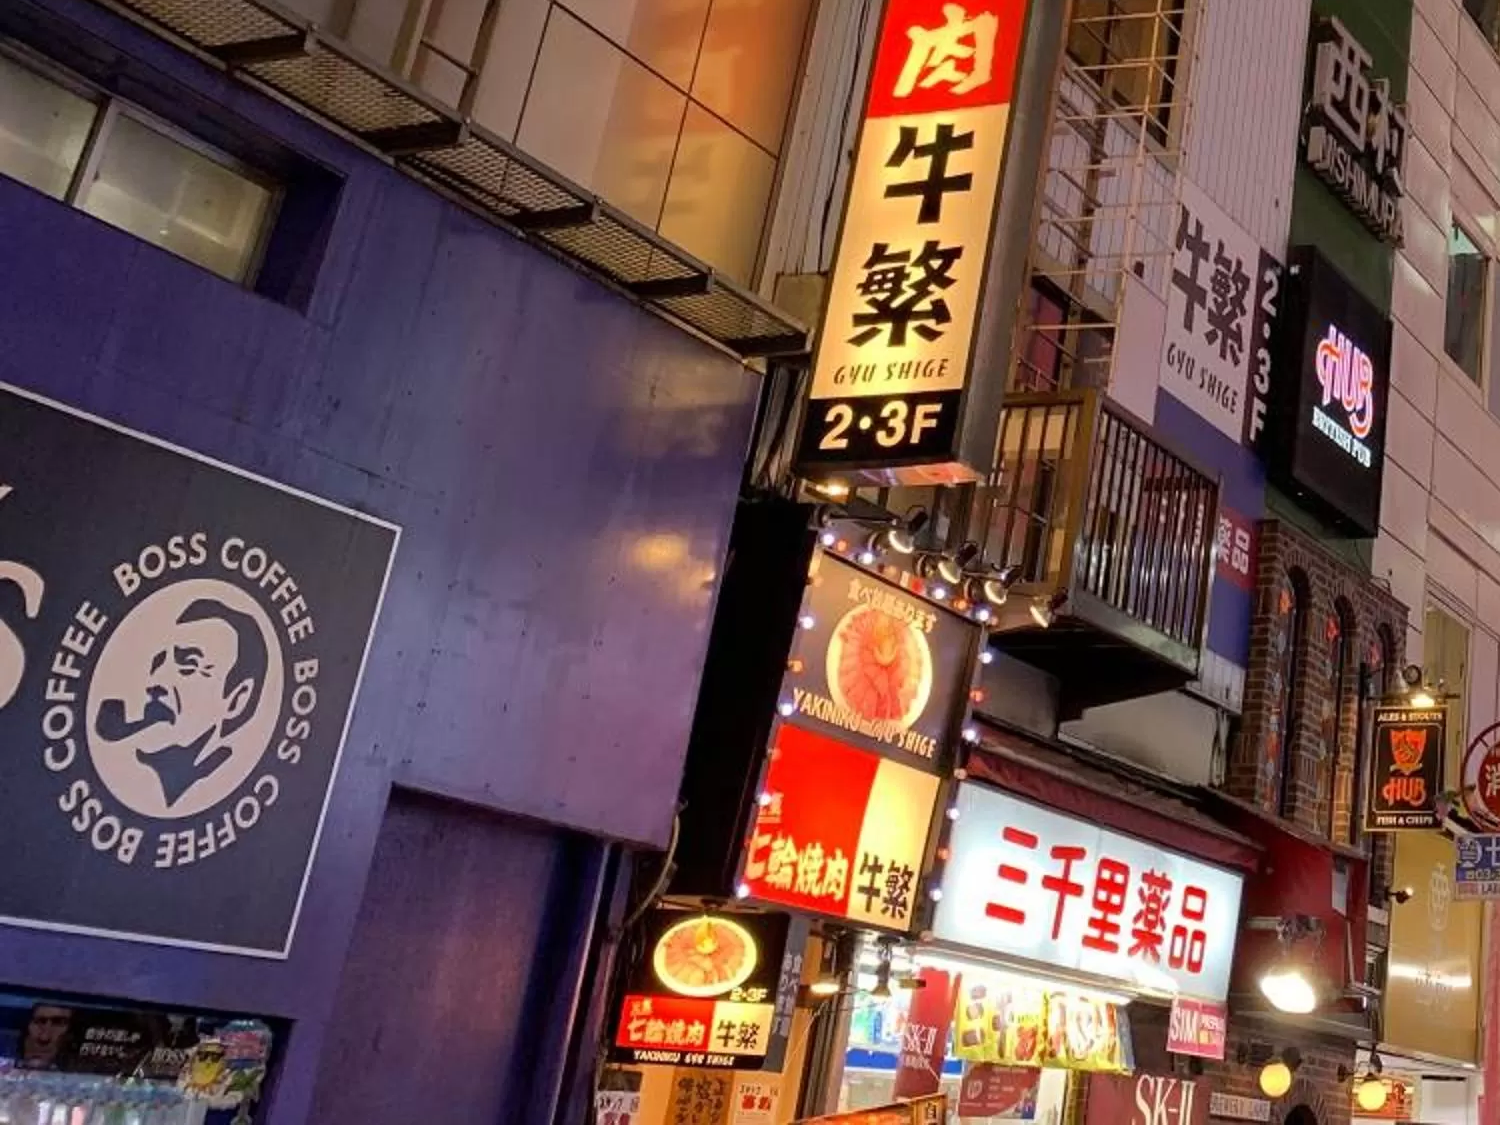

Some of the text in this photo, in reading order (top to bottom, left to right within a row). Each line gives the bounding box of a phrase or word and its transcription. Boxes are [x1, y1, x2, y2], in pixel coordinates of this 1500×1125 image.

[848, 122, 976, 349] 牛繁
[1170, 202, 1250, 368] 牛繁
[834, 356, 948, 386] GYU SHIGE
[1167, 341, 1237, 416] GYU SHIGE
[1316, 323, 1373, 439] HUB
[42, 533, 320, 868] BOSS COFFEE BOSS COFFEE BOSS COFFEE
[1382, 777, 1426, 807] HUB
[745, 827, 849, 902] 七輪焼肉
[856, 851, 915, 919] 牛繁
[984, 825, 1208, 975] 三千里薬品
[1170, 1007, 1199, 1043] SIM
[1131, 1073, 1197, 1125] SK-II
